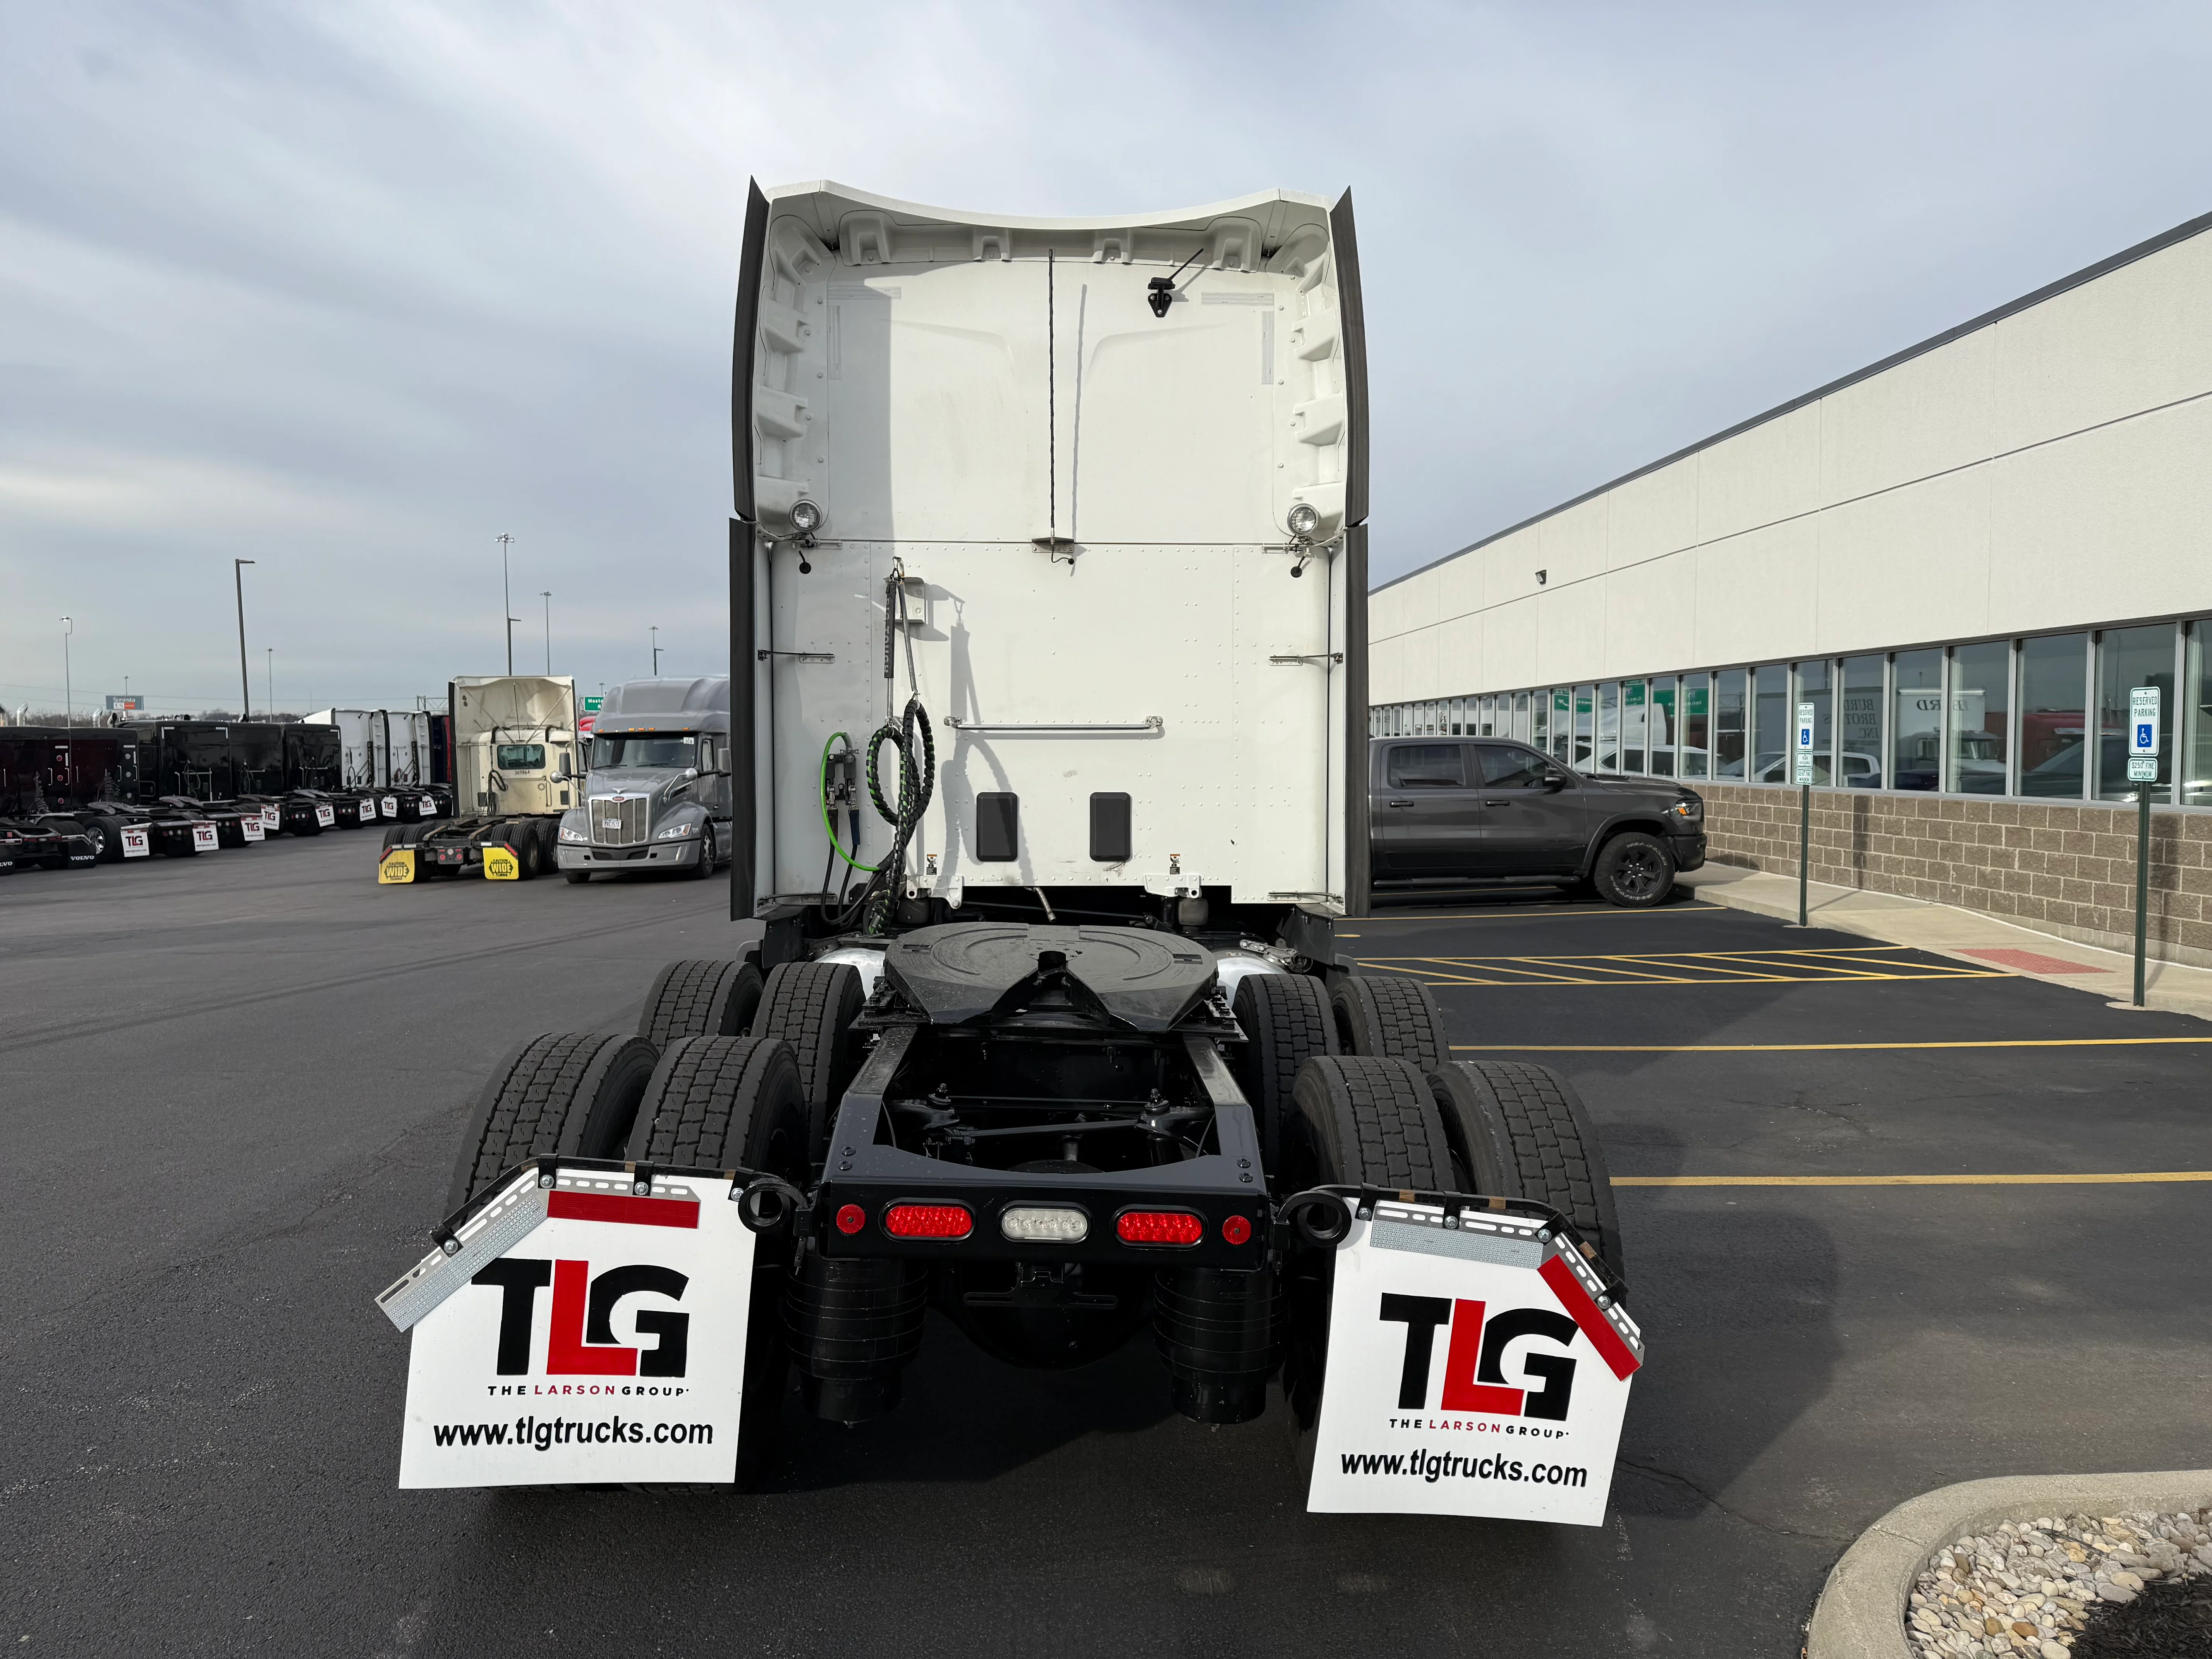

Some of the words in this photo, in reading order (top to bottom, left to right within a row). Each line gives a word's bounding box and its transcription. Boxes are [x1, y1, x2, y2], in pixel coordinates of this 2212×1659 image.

[2133, 697, 2157, 705] RESERVED
[2134, 708, 2156, 717] PARKING
[362, 805, 372, 813] TLG
[383, 801, 393, 810] TLG
[264, 811, 275, 821] TLG
[318, 809, 330, 819] TLG
[245, 823, 259, 832] TLG
[196, 831, 213, 841] TLG
[125, 836, 143, 847] TLG
[386, 867, 407, 877] WIDE
[491, 863, 511, 872] WIDE
[471, 1258, 689, 1377] TLG
[1379, 1292, 1579, 1421] TLG
[488, 1386, 526, 1396] THE
[534, 1385, 615, 1395] LARSON
[622, 1386, 685, 1396] GROUP
[433, 1415, 713, 1451] www.tlgtrucks.com
[1389, 1419, 1422, 1429] THE
[1429, 1420, 1500, 1433] LARSON
[1506, 1425, 1564, 1439] GROUP
[1341, 1448, 1587, 1487] www.tlgtrucks.com
